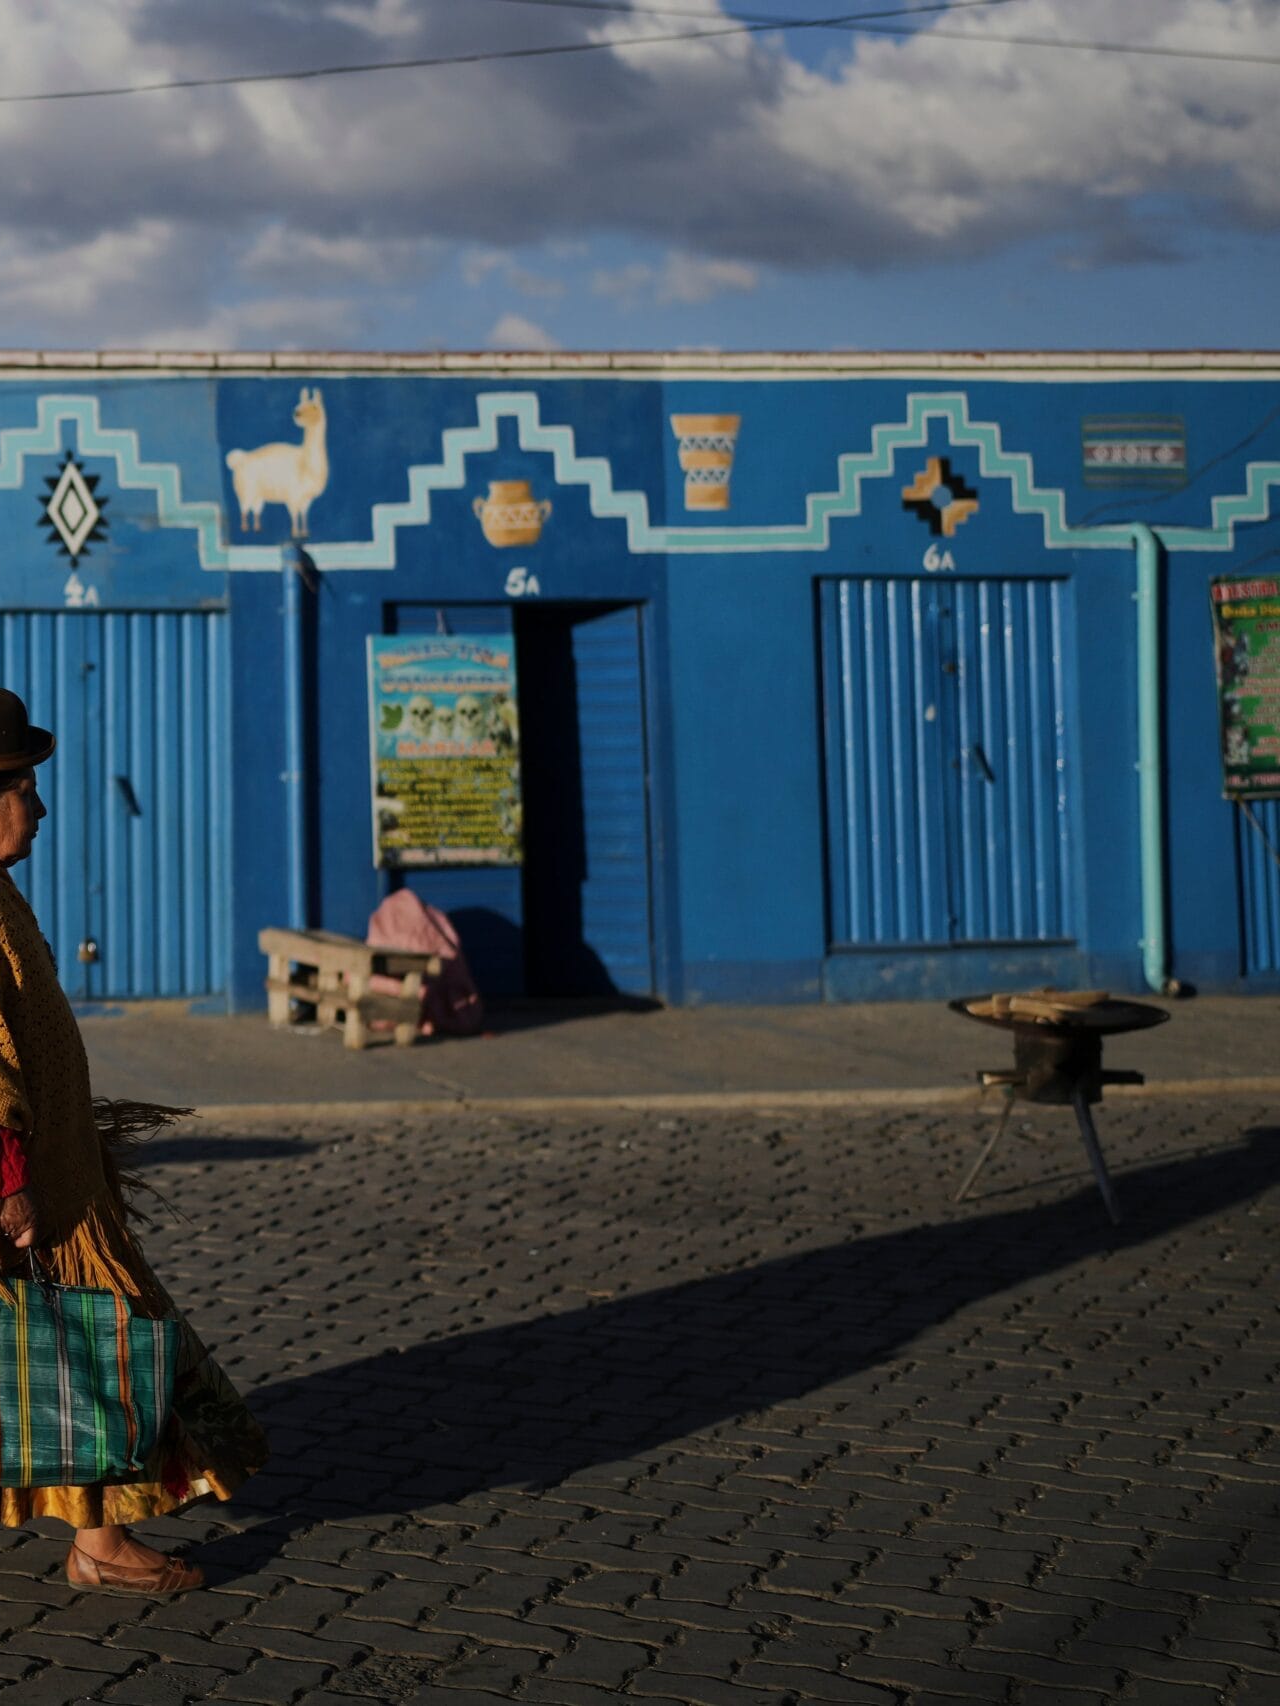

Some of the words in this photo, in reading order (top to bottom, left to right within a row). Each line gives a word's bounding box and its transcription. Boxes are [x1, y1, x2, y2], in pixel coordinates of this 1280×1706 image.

[922, 543, 956, 573] 6A
[63, 573, 100, 608] 4A
[504, 567, 541, 598] 5A
